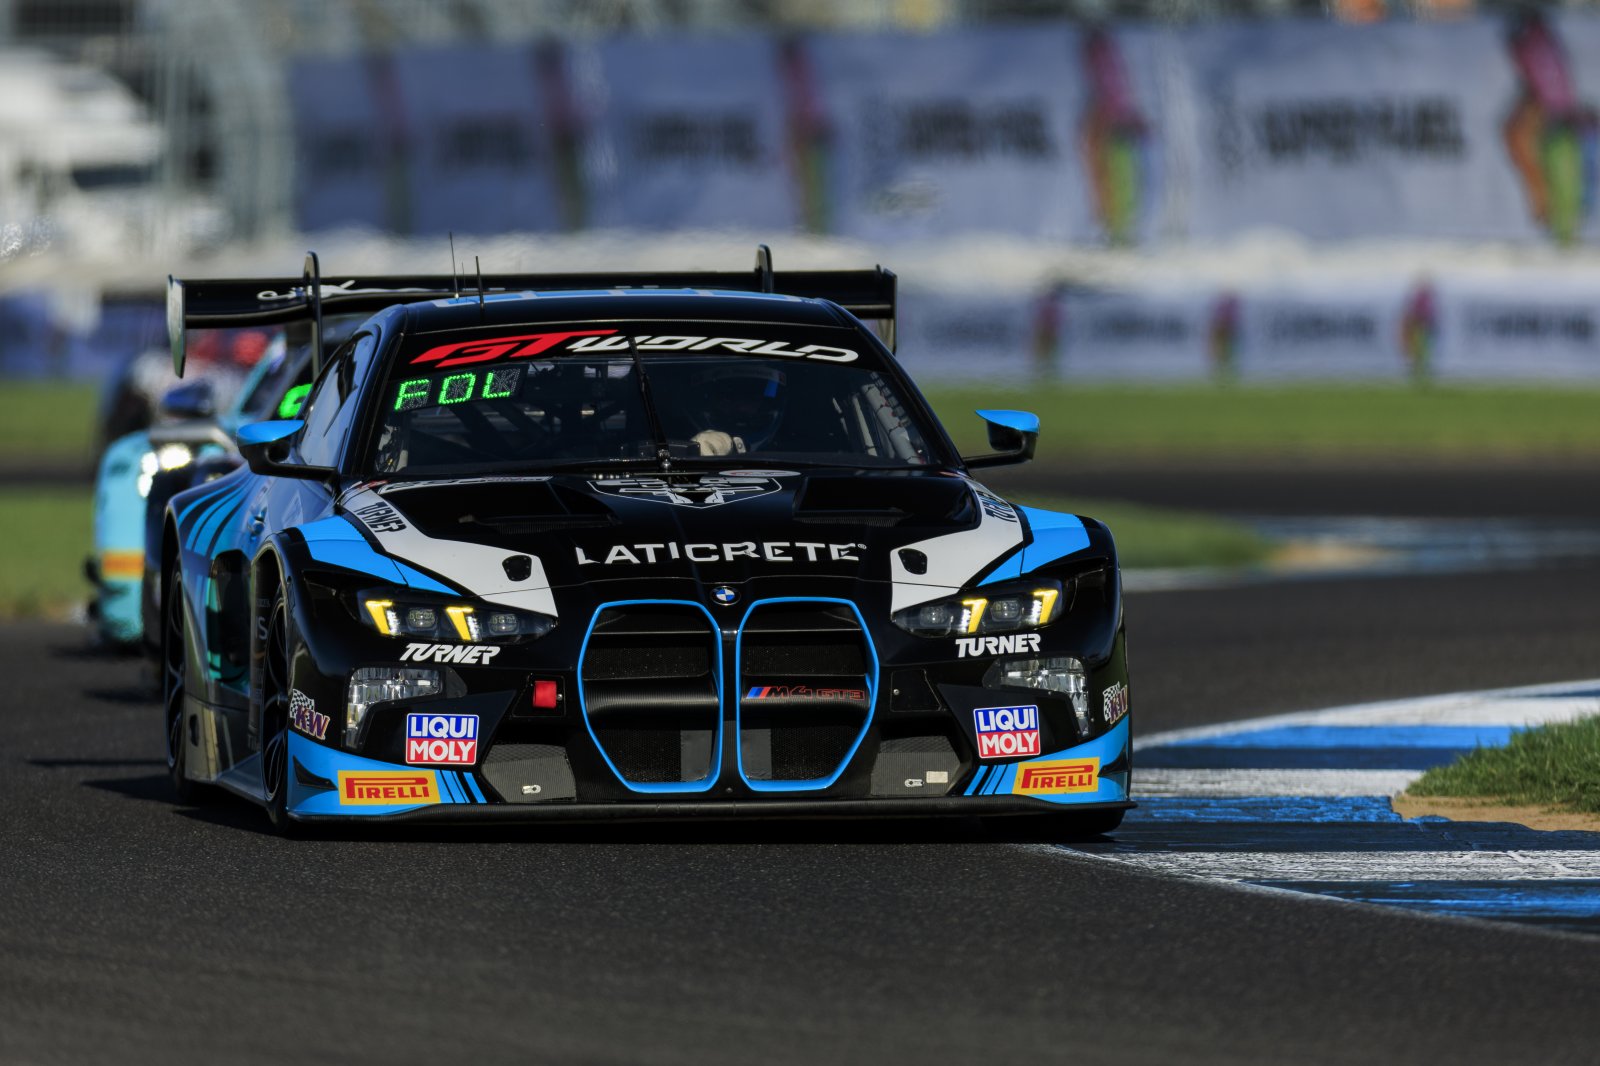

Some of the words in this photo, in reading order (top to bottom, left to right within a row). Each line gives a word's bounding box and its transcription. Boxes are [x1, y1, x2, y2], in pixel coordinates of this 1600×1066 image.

[394, 371, 511, 411] FOL
[353, 501, 407, 533] TURNER
[399, 642, 501, 665] TURNER
[955, 633, 1041, 658] TURNER
[767, 686, 813, 699] M4
[816, 689, 865, 700] GT3
[294, 702, 330, 741] KW
[410, 716, 474, 739] LIQUI
[978, 708, 1036, 732] LIQUI
[410, 740, 476, 761] MOLY
[981, 732, 1037, 755] MOLY
[345, 777, 430, 799] PIRELLI
[1020, 764, 1094, 789] PIRELLI
